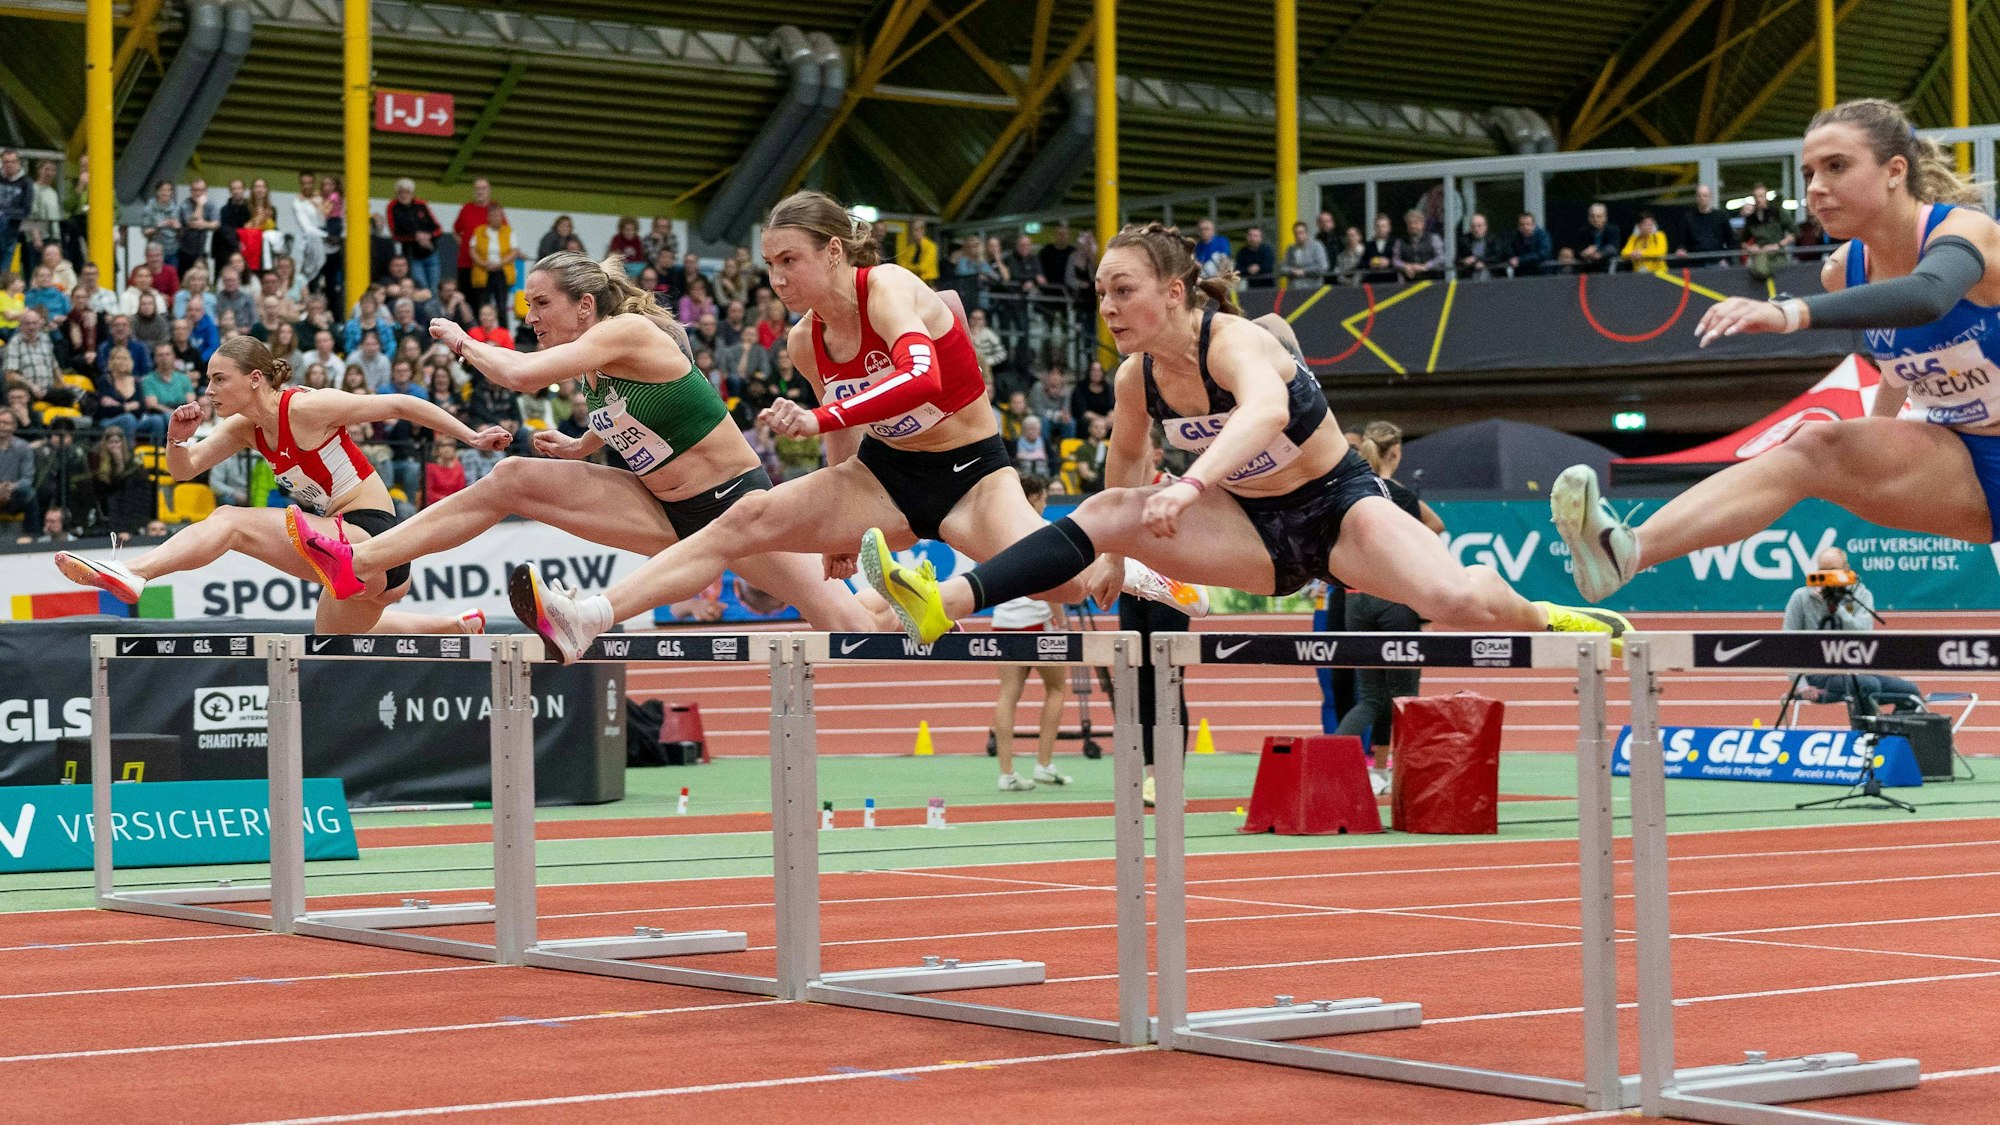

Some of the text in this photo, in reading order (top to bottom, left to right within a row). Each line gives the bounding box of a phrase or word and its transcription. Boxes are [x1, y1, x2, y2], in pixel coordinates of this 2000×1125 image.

[385, 94, 424, 127] I-J
[592, 411, 619, 432] GLS.
[1549, 541, 1571, 556] GU
[1688, 527, 1837, 580] WGV
[1847, 537, 1975, 553] GUT VERSICHERT.
[1440, 530, 1541, 582] GV
[1862, 555, 1960, 571] UND GUT IST.
[193, 640, 212, 653] GLS.
[352, 639, 375, 653] WGV
[396, 639, 419, 654] GLS.
[603, 640, 630, 656] WGV
[657, 640, 685, 656] GLS.
[968, 638, 1002, 656] GLS.
[1295, 641, 1337, 661] WGV
[1381, 641, 1425, 662] GLS.
[1820, 640, 1999, 666] WGV GLS.
[239, 694, 269, 711] PL
[406, 694, 564, 722] NOVAN
[199, 733, 268, 749] CHARITY-PAR
[1708, 730, 1789, 764] GLS.
[1799, 732, 1884, 768] GLS.
[1702, 764, 1772, 778] Parcels to People
[1793, 768, 1824, 778] Parcels
[1825, 769, 1835, 779] to
